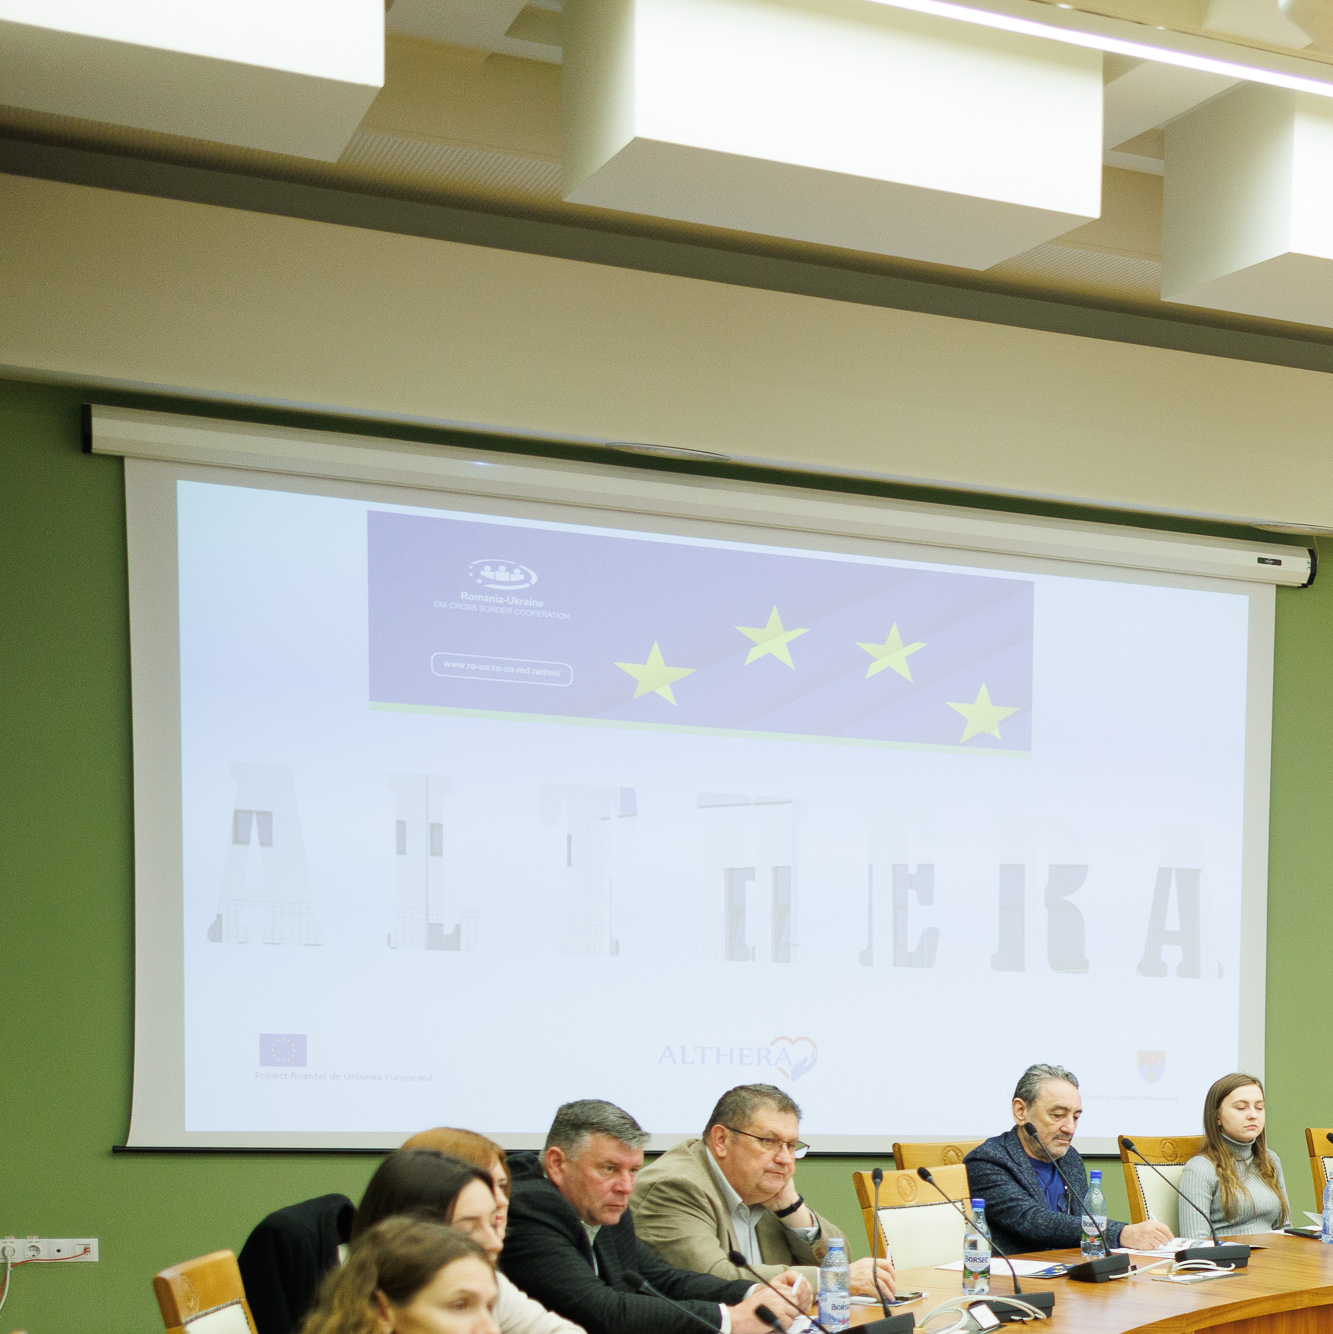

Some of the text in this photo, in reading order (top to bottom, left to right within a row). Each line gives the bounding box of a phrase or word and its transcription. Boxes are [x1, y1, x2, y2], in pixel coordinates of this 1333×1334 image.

[461, 592, 544, 607] Romania-Ukraine
[479, 604, 513, 615] BORDER
[514, 608, 570, 620] COOPERATION
[658, 1045, 793, 1066] ALTHERA
[254, 1072, 289, 1081] Proiect
[329, 1073, 342, 1082] de
[344, 1073, 383, 1082] Uniunea
[384, 1073, 433, 1083] Europeană
[965, 1255, 988, 1263] BORSEC
